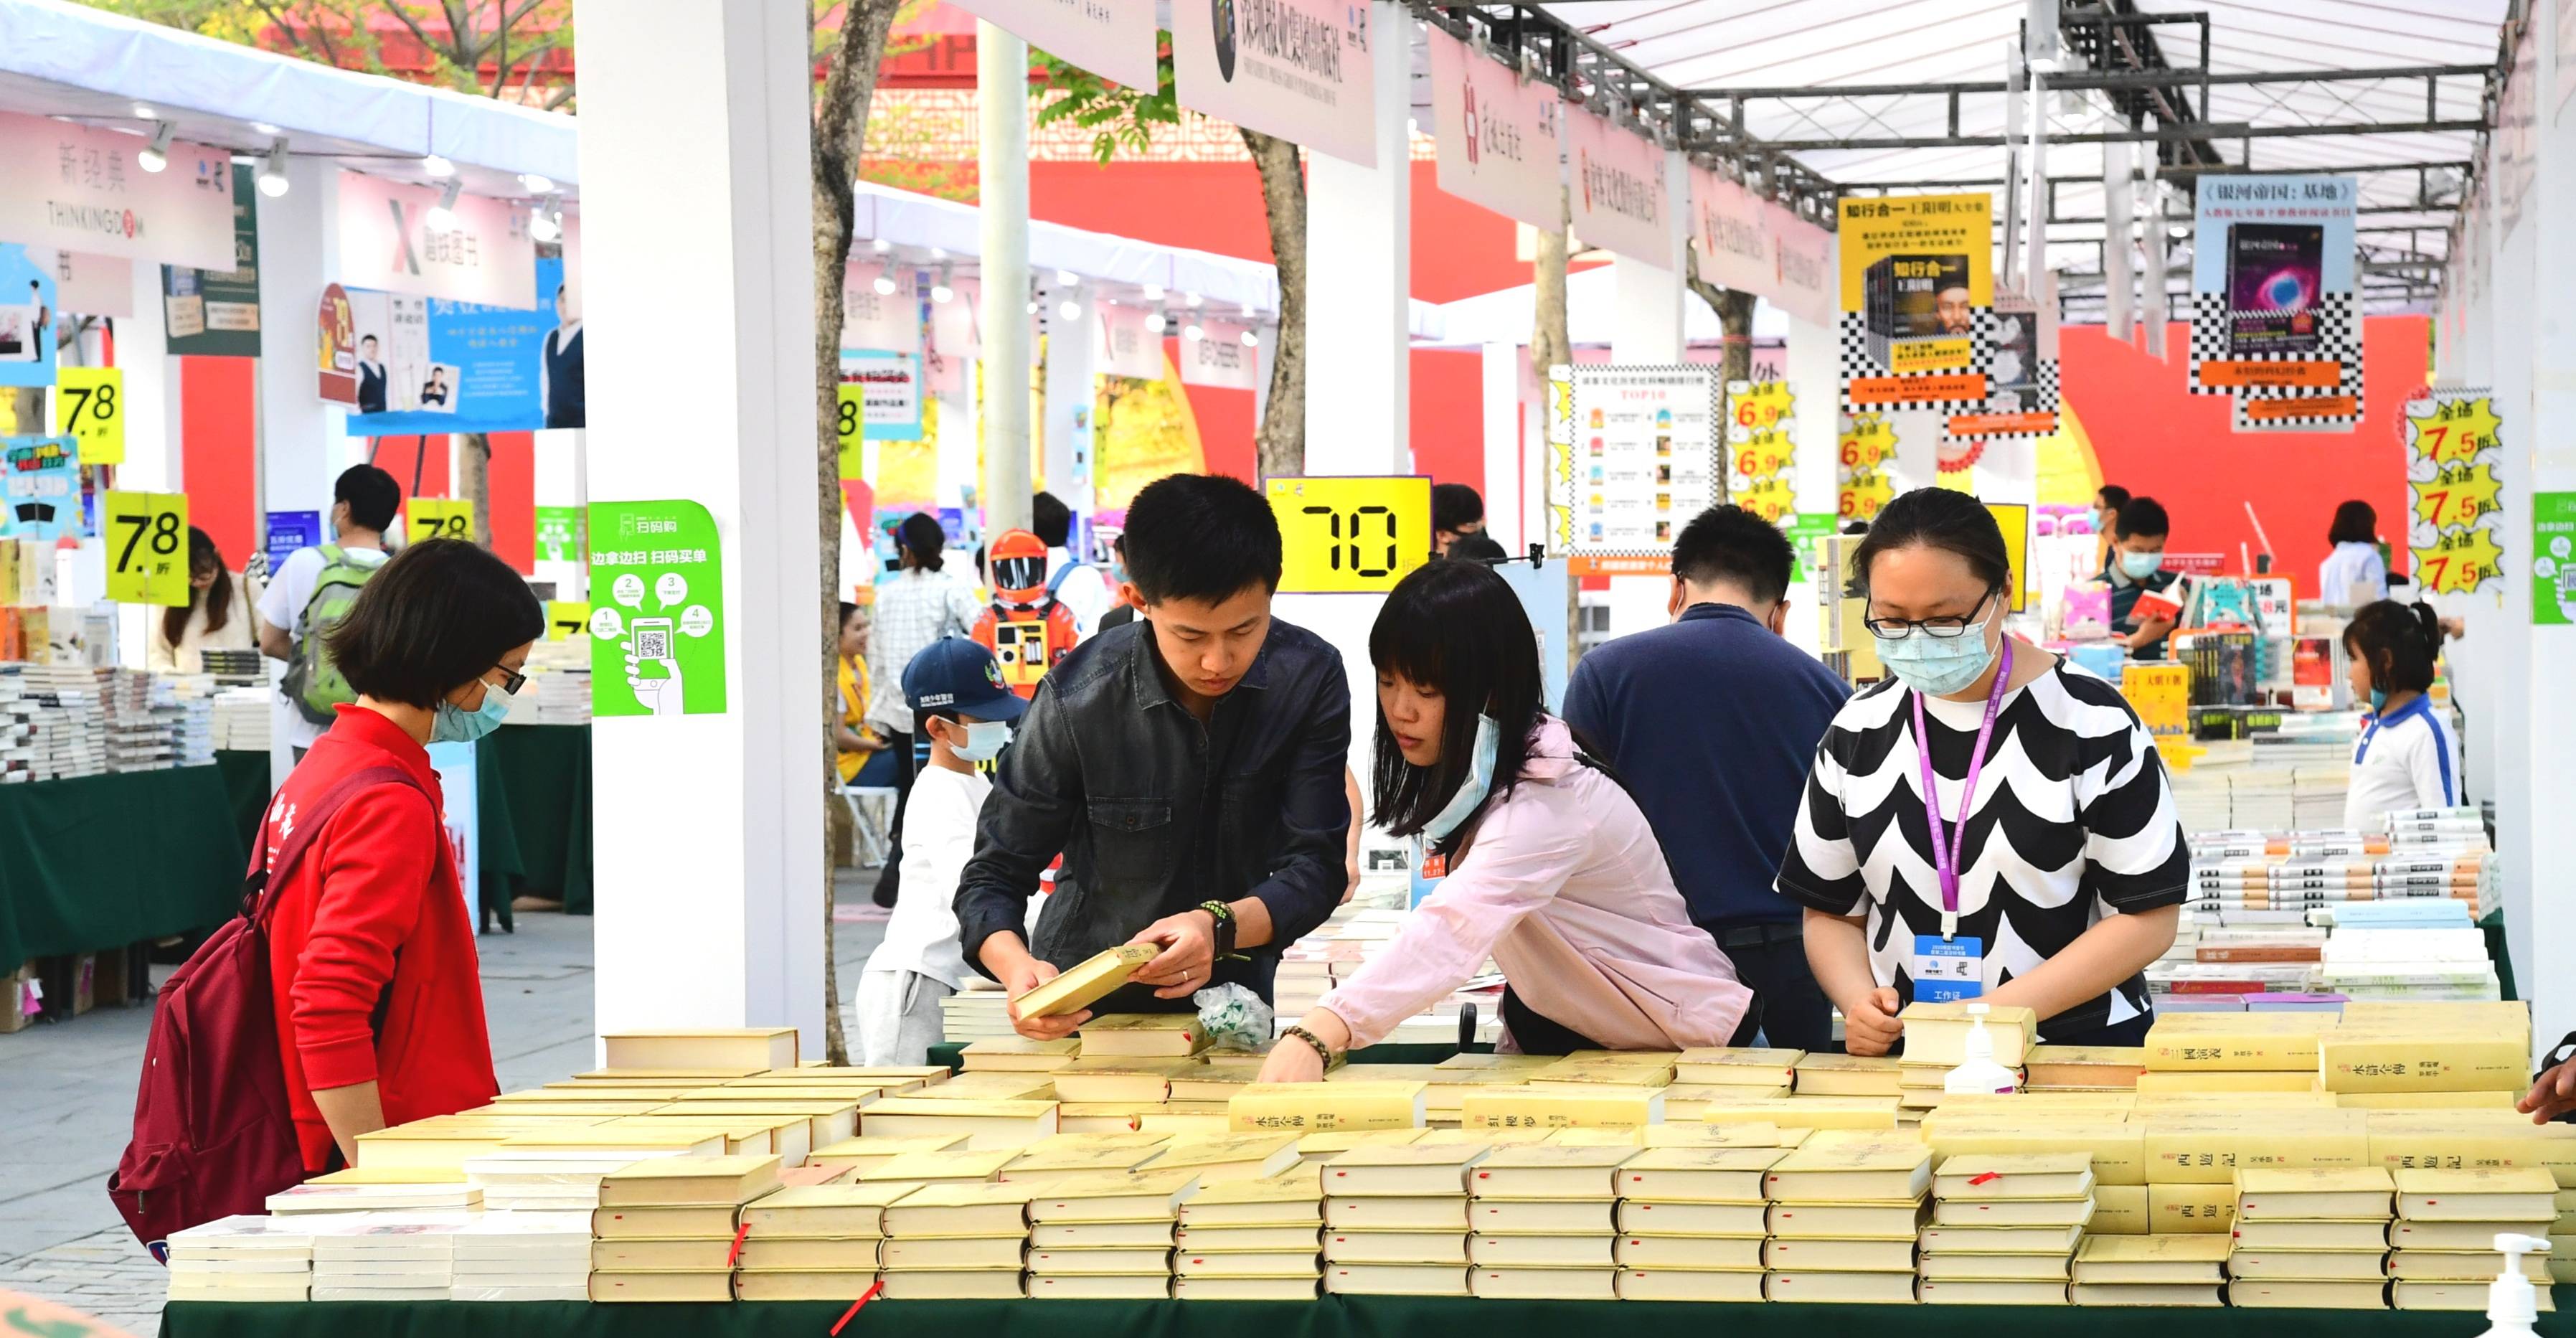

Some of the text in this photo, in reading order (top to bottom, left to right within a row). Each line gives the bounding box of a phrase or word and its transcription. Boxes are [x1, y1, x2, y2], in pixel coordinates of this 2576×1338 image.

[59, 141, 126, 192] 新经典
[2204, 183, 2351, 201] 《银河帝国：基地》
[636, 521, 677, 534] 扫码购
[1301, 506, 1397, 577] 70
[591, 549, 707, 566] 边拿边扫 扫码买单
[156, 562, 171, 575] 折
[625, 578, 632, 588] 2
[668, 577, 675, 587] 3
[602, 611, 608, 621] 1
[692, 608, 699, 618] 4
[1933, 991, 1961, 1000] 工作证
[2176, 1153, 2236, 1167] 西遊記
[2401, 1156, 2462, 1169] 西遊記
